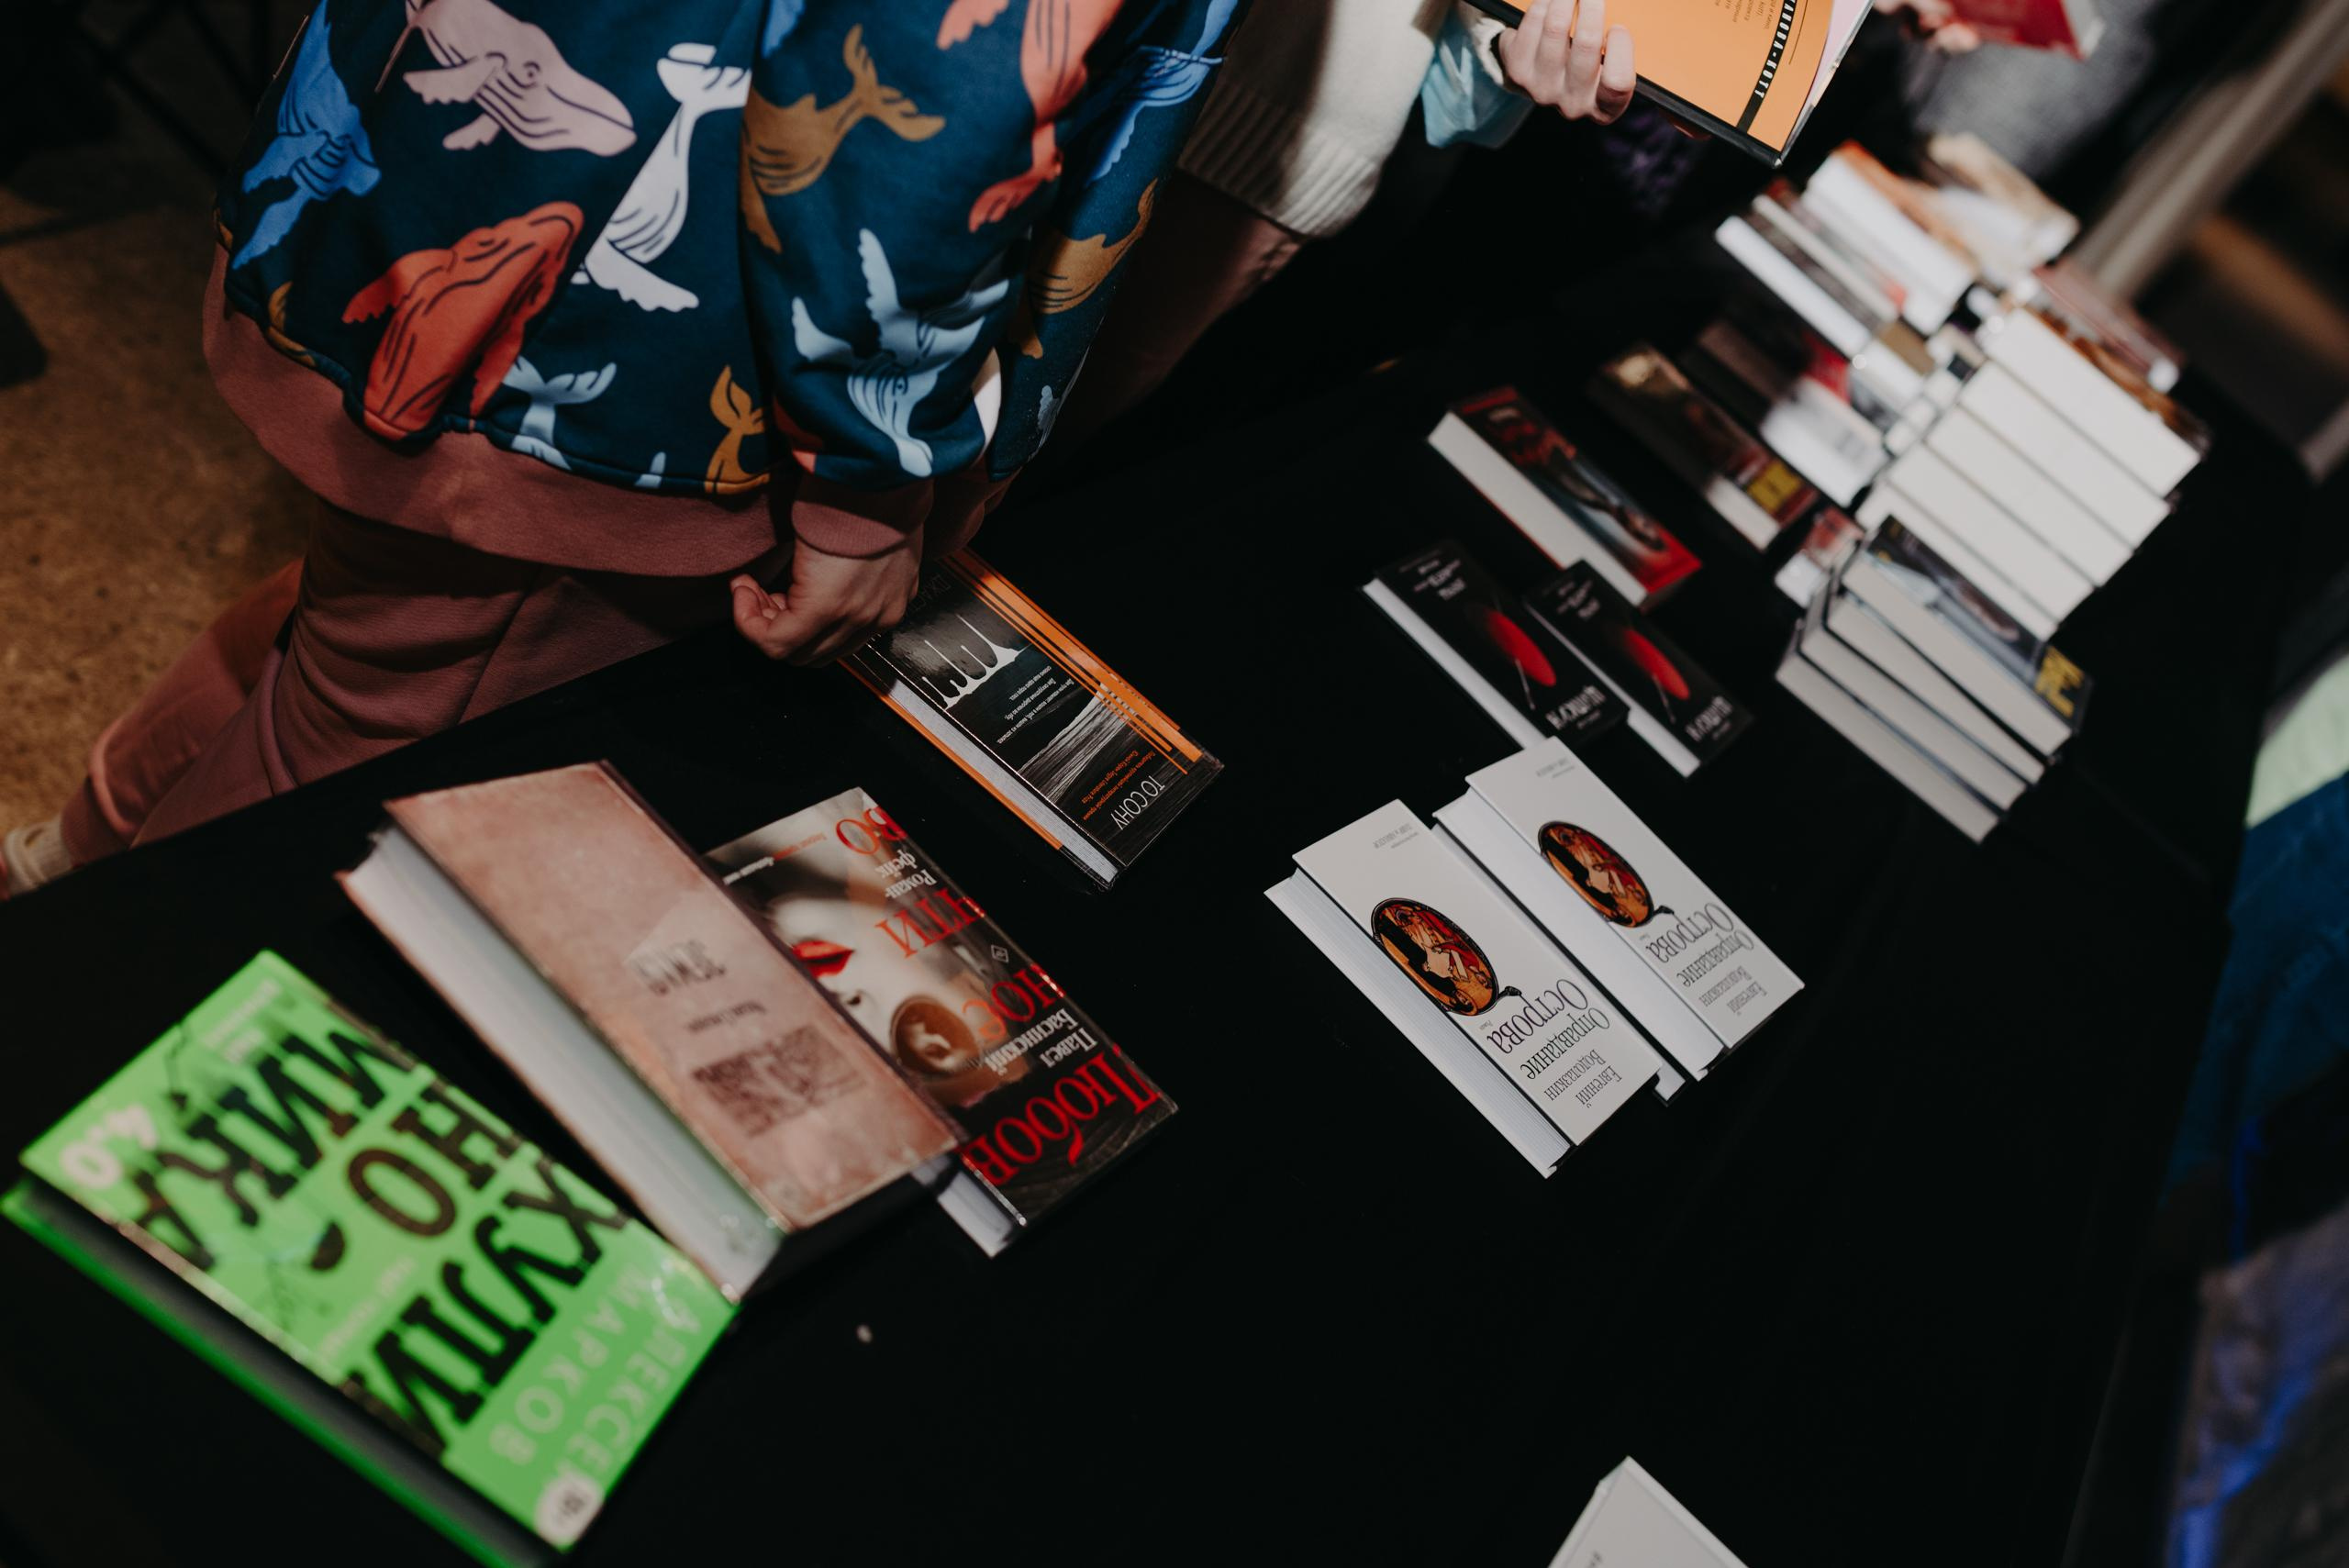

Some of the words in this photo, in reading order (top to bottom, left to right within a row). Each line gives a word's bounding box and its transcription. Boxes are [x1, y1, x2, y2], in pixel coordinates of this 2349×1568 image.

[1754, 0, 1796, 98] АНОВА-КОТТ
[1109, 792, 1146, 830] СОНУ
[1139, 774, 1164, 795] ТО
[872, 846, 921, 881] фейк
[880, 868, 938, 901] Роман-
[1644, 903, 1732, 964] Острова
[1675, 929, 1753, 987] Оправдание
[979, 1007, 1077, 1077] Басинский
[1037, 1026, 1098, 1069] Павел
[1486, 980, 1586, 1054] Острова
[1519, 1008, 1609, 1079] Оправдание
[1542, 1046, 1607, 1103] Водолазкин
[1574, 1063, 1622, 1109] Евгений
[59, 1104, 158, 1192] 4.0
[123, 997, 417, 1273] МИКА
[351, 1077, 523, 1237] НО
[337, 1156, 627, 1460] ХУЛИ
[484, 1259, 657, 1469] МАРКОВ
